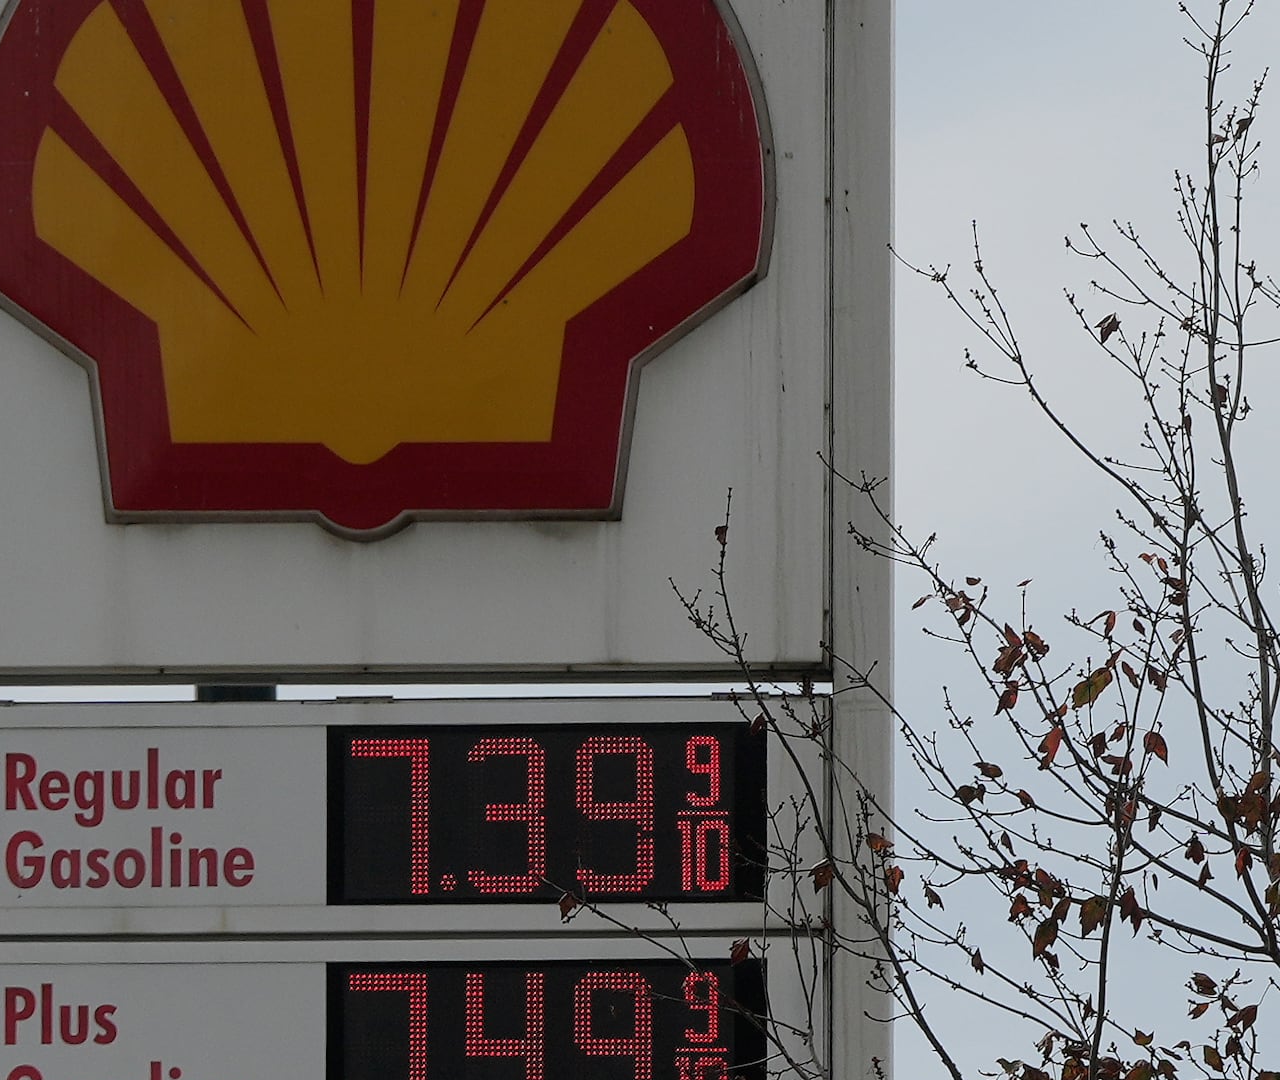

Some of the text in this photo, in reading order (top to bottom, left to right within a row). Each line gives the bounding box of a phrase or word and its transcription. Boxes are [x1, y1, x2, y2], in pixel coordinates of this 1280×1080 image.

[5, 748, 222, 828] Regular
[351, 736, 654, 894] 7.39
[4, 828, 255, 888] Gasoline
[4, 985, 118, 1045] Plus
